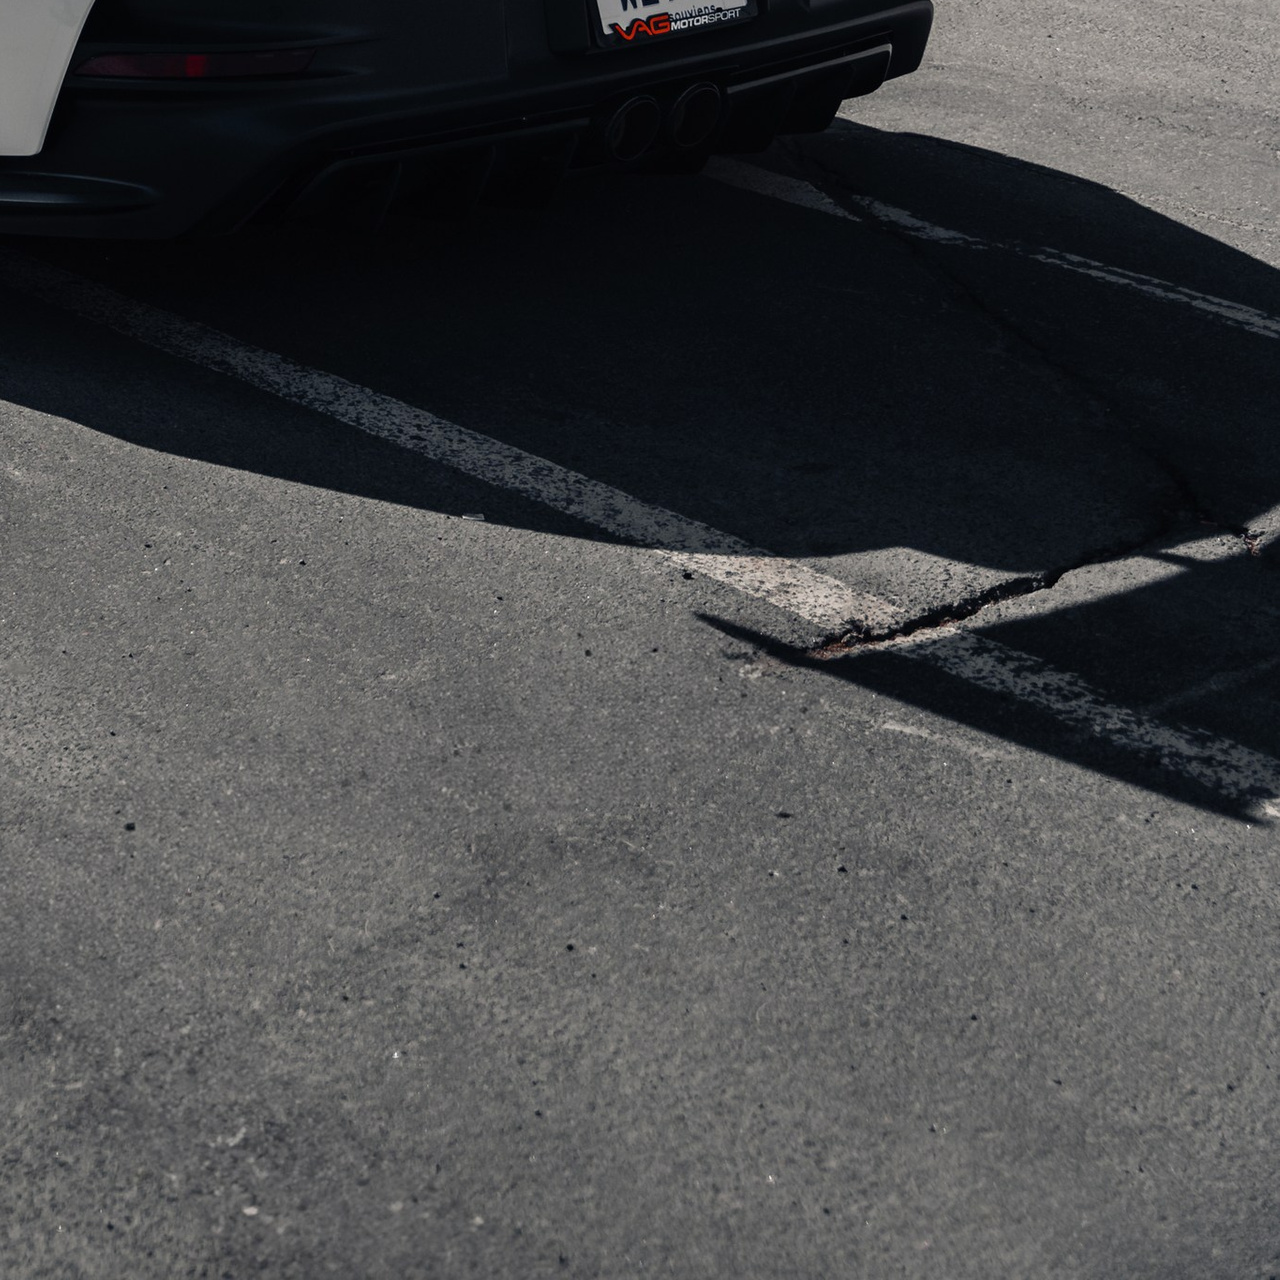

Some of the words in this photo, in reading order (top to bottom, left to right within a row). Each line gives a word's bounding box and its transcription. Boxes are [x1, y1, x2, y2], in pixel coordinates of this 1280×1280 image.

[612, 13, 671, 41] VAG
[671, 7, 741, 31] MOTORSPORT
[669, 4, 716, 22] souviens
